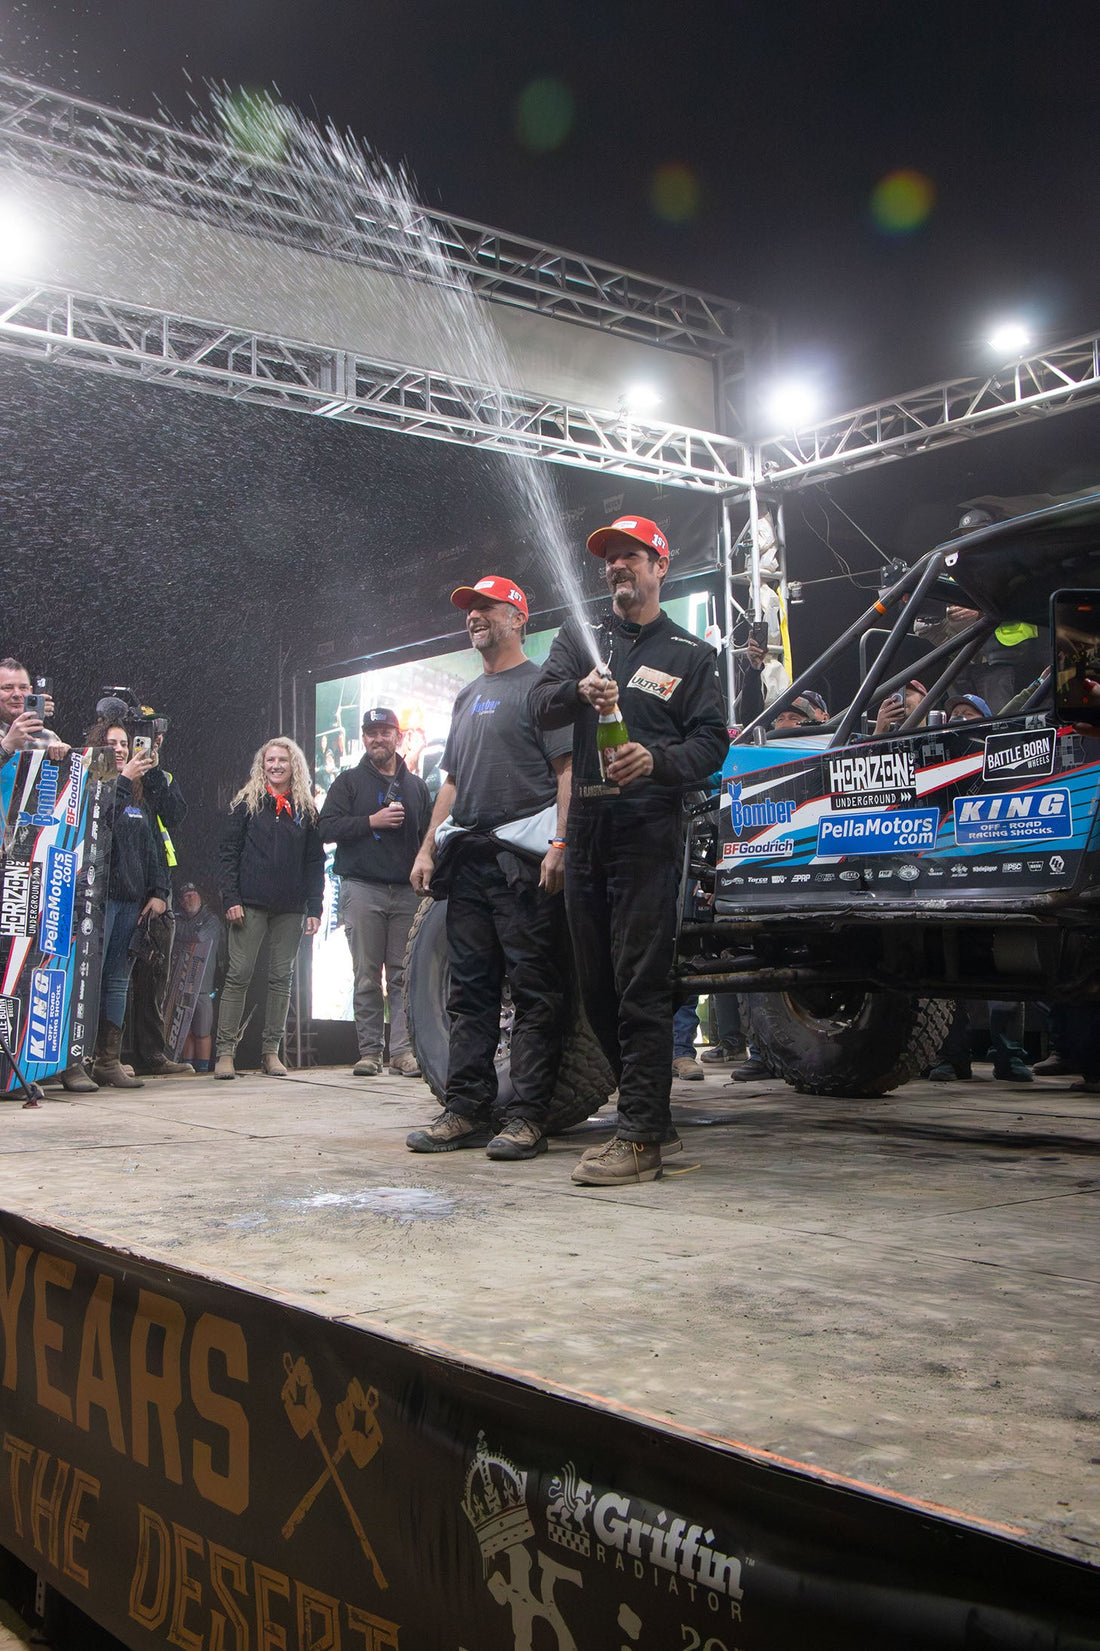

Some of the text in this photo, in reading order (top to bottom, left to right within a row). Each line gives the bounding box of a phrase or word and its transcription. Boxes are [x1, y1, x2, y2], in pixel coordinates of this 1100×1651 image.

[651, 534, 666, 549] 1ST
[508, 589, 523, 602] 1ST
[987, 737, 1051, 769] BATTLE BORN
[1027, 755, 1050, 769] WHEELS
[65, 752, 82, 827] BFGoodrich
[829, 753, 909, 793] HORIZON
[32, 759, 60, 827] Bomber
[835, 793, 897, 808] UNDERGROUND
[959, 792, 1068, 822] KING
[731, 796, 797, 831] Bomber
[821, 816, 933, 839] PellaMotors
[723, 839, 794, 856] BFGoodrich
[893, 830, 933, 845] .com
[968, 827, 1008, 839] RACING
[63, 853, 73, 887] .com
[0, 866, 30, 937] HORIZON
[28, 880, 41, 934] UNDERGROUND
[44, 852, 65, 952] PellaMotors
[30, 972, 50, 1060] KING
[0, 1239, 249, 1515] YEARS
[3, 1433, 101, 1589] THE
[593, 1493, 744, 1600] Griffin
[596, 1543, 743, 1623] RADIATOR
